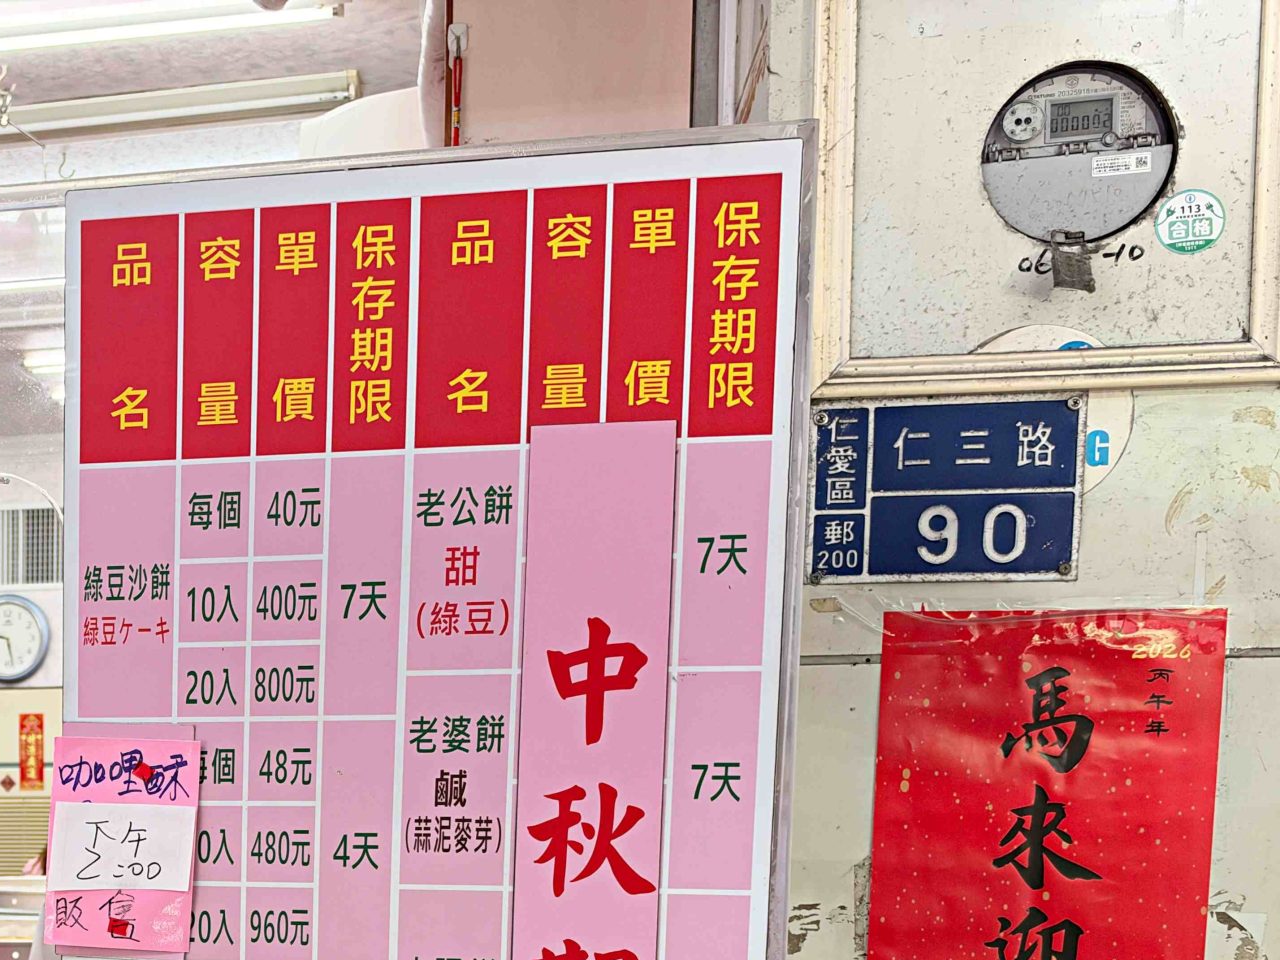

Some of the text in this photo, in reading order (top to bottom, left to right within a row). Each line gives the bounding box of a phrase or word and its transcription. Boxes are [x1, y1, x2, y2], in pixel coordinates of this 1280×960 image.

[1170, 219, 1211, 238] 合格
[1180, 204, 1201, 214] 113
[349, 224, 396, 425] 保存期限
[708, 201, 761, 409] 保存期限
[826, 415, 859, 505] 仁愛區
[893, 421, 1056, 471] 仁三路
[188, 490, 241, 530] 每個
[266, 487, 321, 528] 40元
[416, 485, 513, 528] 老公餅
[824, 520, 854, 545] 郵
[917, 503, 1027, 565] 90
[445, 545, 480, 587] 甜
[696, 533, 747, 575] 7天
[817, 549, 858, 570] 200
[83, 563, 170, 602] 綠豆沙餅
[256, 582, 317, 622] 400元
[340, 580, 387, 620] 7天
[187, 584, 239, 624] 10入
[416, 598, 509, 639] (綠豆)
[1132, 644, 1191, 660] 2026
[185, 668, 237, 706] 20入
[254, 665, 315, 704] 800元
[1145, 668, 1174, 738] 丙午年
[409, 715, 505, 754] 老婆餅
[259, 747, 312, 786] 48元
[690, 762, 741, 802] 7天
[434, 769, 468, 808] 鹹
[85, 820, 148, 858] 下午
[197, 828, 234, 865] 0入
[250, 829, 310, 866] 480元
[333, 833, 379, 870] 4天
[405, 815, 502, 855] (蒜泥麥芽)
[250, 909, 309, 946] 960元
